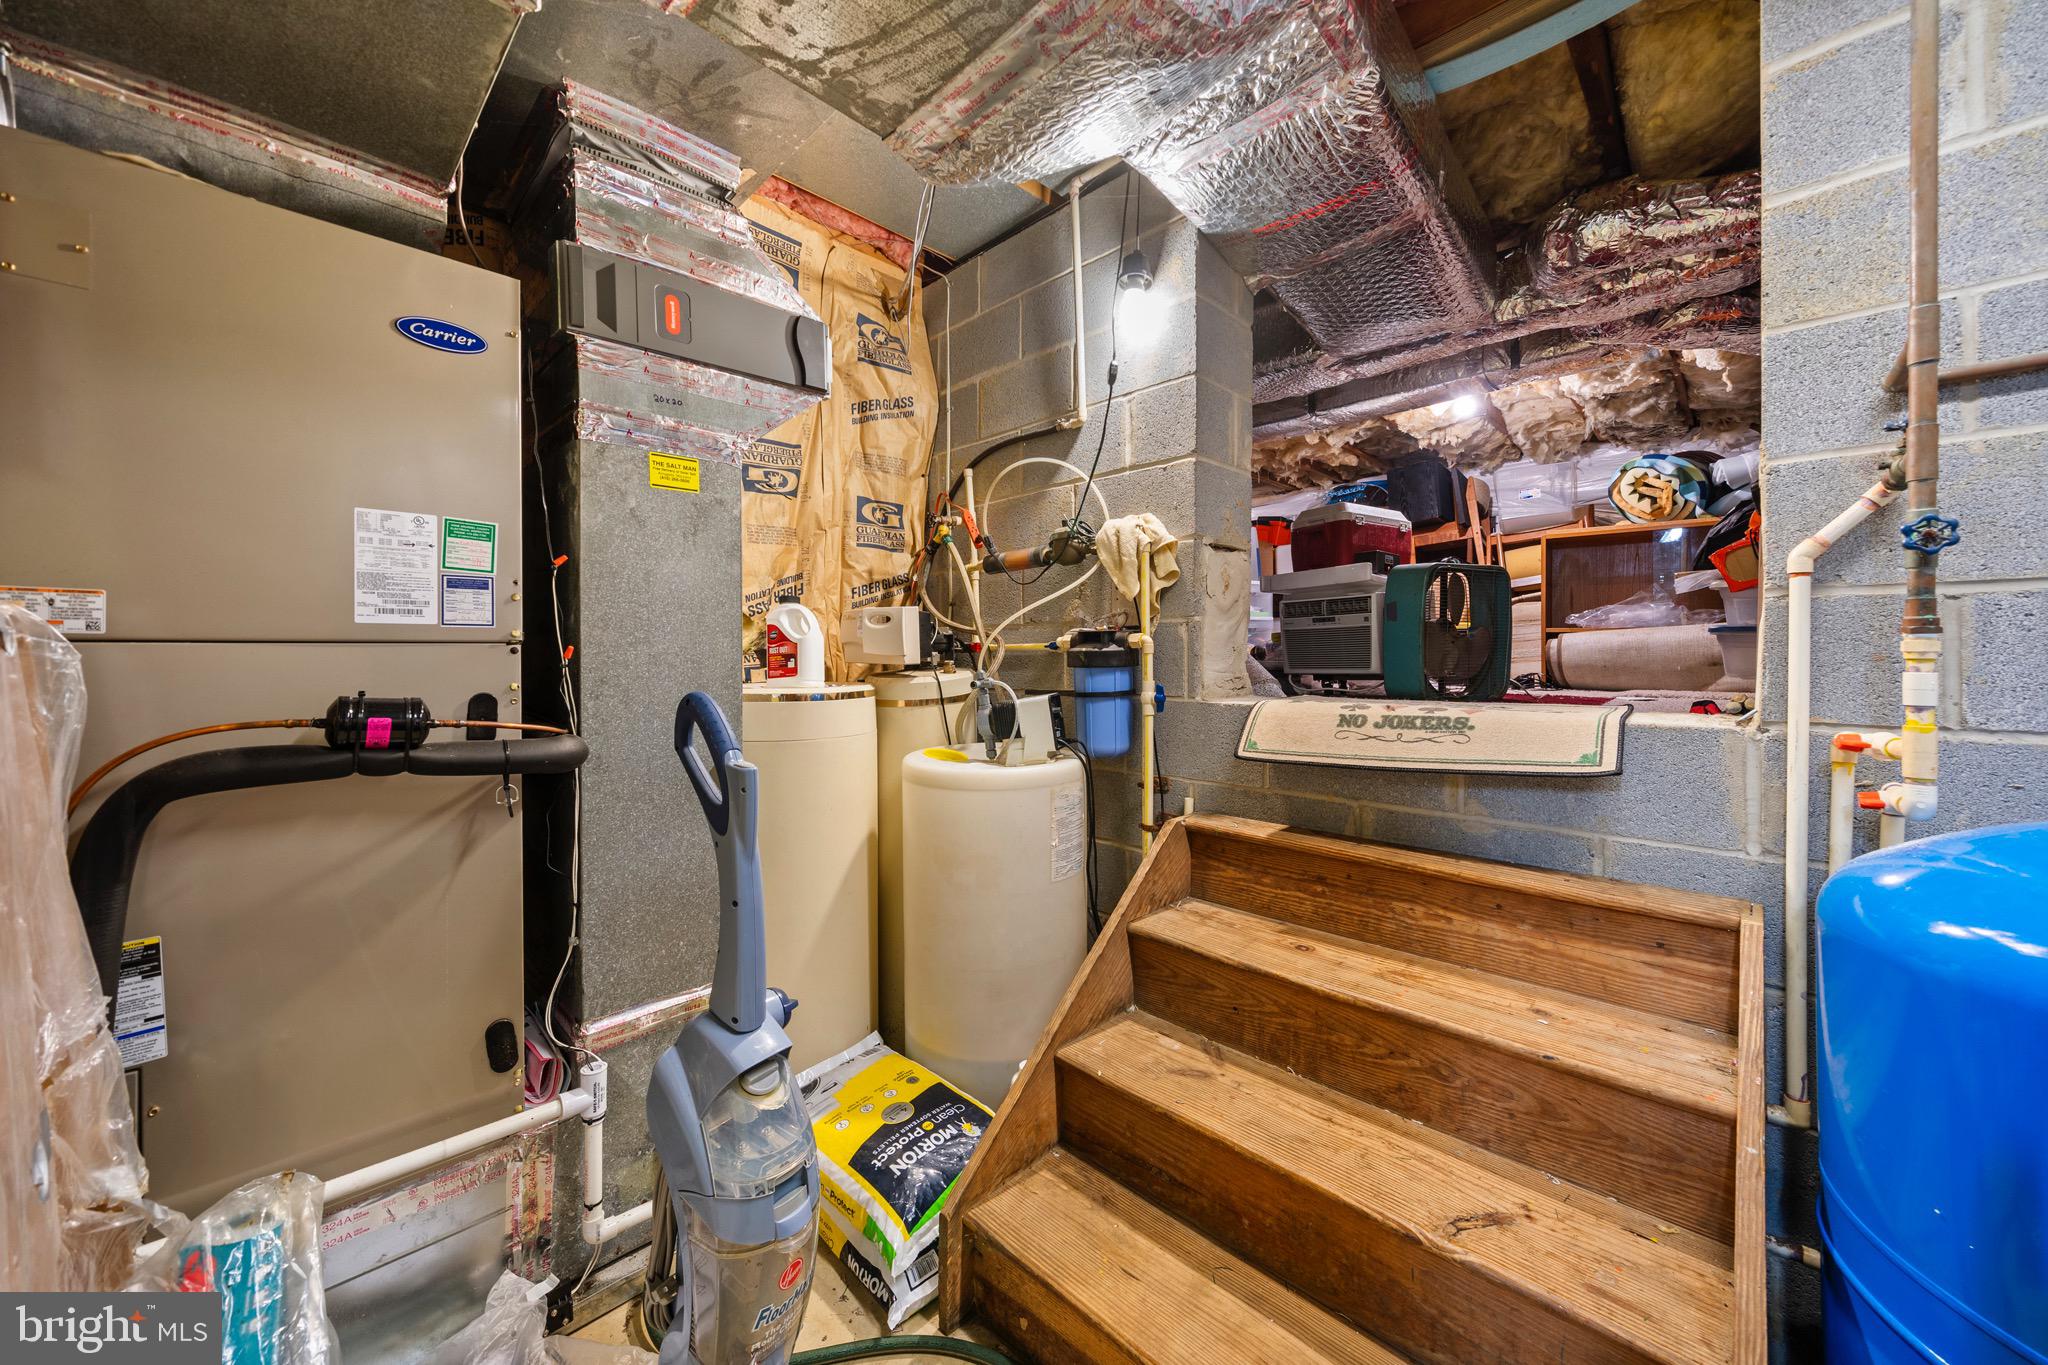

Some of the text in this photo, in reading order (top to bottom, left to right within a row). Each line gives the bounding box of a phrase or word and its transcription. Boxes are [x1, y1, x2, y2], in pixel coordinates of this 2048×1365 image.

[409, 322, 477, 346] Carrier
[851, 396, 914, 415] FIBER GLASS
[851, 409, 915, 425] BUILDING INSULATION
[742, 450, 803, 466] GUARDIAN
[748, 442, 803, 457] FIBERGLAS
[776, 572, 804, 587] BUILDING
[851, 573, 910, 599] FIBER GLASS
[851, 596, 879, 609] BUILDING
[1336, 713, 1475, 731] NO JOKERS.
[932, 1103, 966, 1125] Clean
[872, 1102, 952, 1156] WATER SOFTENER PELLETS
[871, 1126, 925, 1168] Protect
[889, 1124, 958, 1177] MORTON
[830, 1189, 856, 1219] Protect
[321, 1216, 352, 1234] 324A
[322, 1232, 353, 1250] 324A
